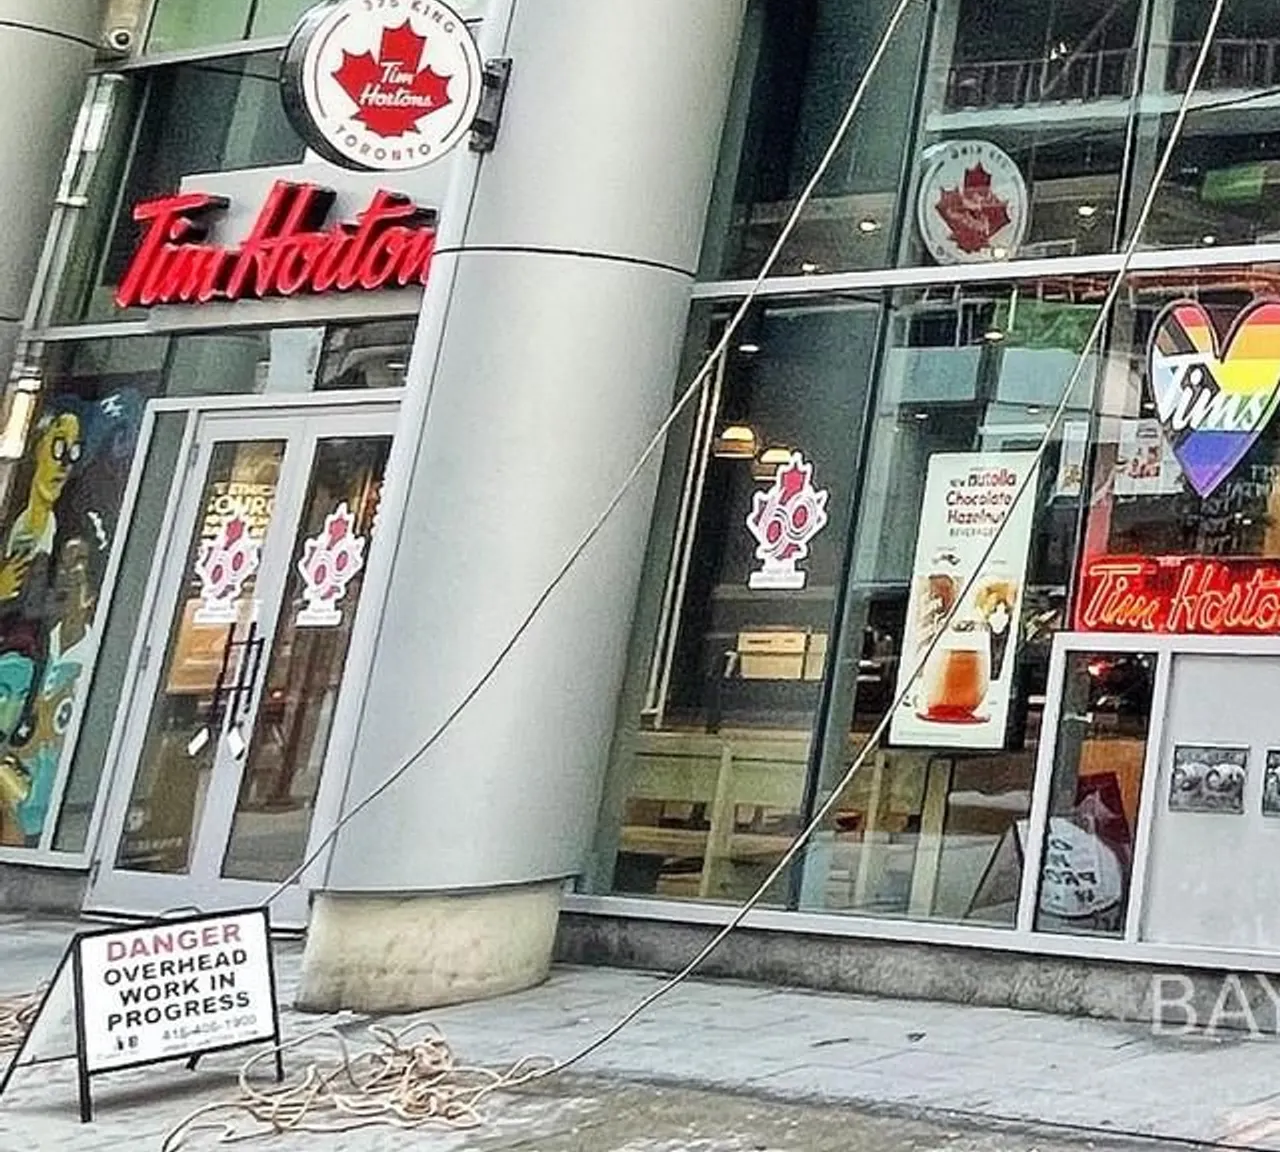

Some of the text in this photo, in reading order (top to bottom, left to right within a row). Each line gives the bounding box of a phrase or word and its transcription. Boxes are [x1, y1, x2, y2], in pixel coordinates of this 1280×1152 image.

[410, 0, 456, 34] KING
[379, 61, 414, 84] Tim
[359, 84, 432, 107] Hortons
[335, 124, 431, 161] TORONTO
[115, 178, 438, 308] Tim Horton
[1153, 353, 1265, 430] Tims
[946, 490, 1012, 506] Chocolate
[947, 508, 1005, 524] Hazelnut
[1084, 563, 1156, 626] Tim
[107, 923, 242, 962] DANGER
[103, 949, 248, 986] OVERHEAD
[119, 972, 236, 1007] WORK IN
[108, 991, 250, 1031] PROGRESS
